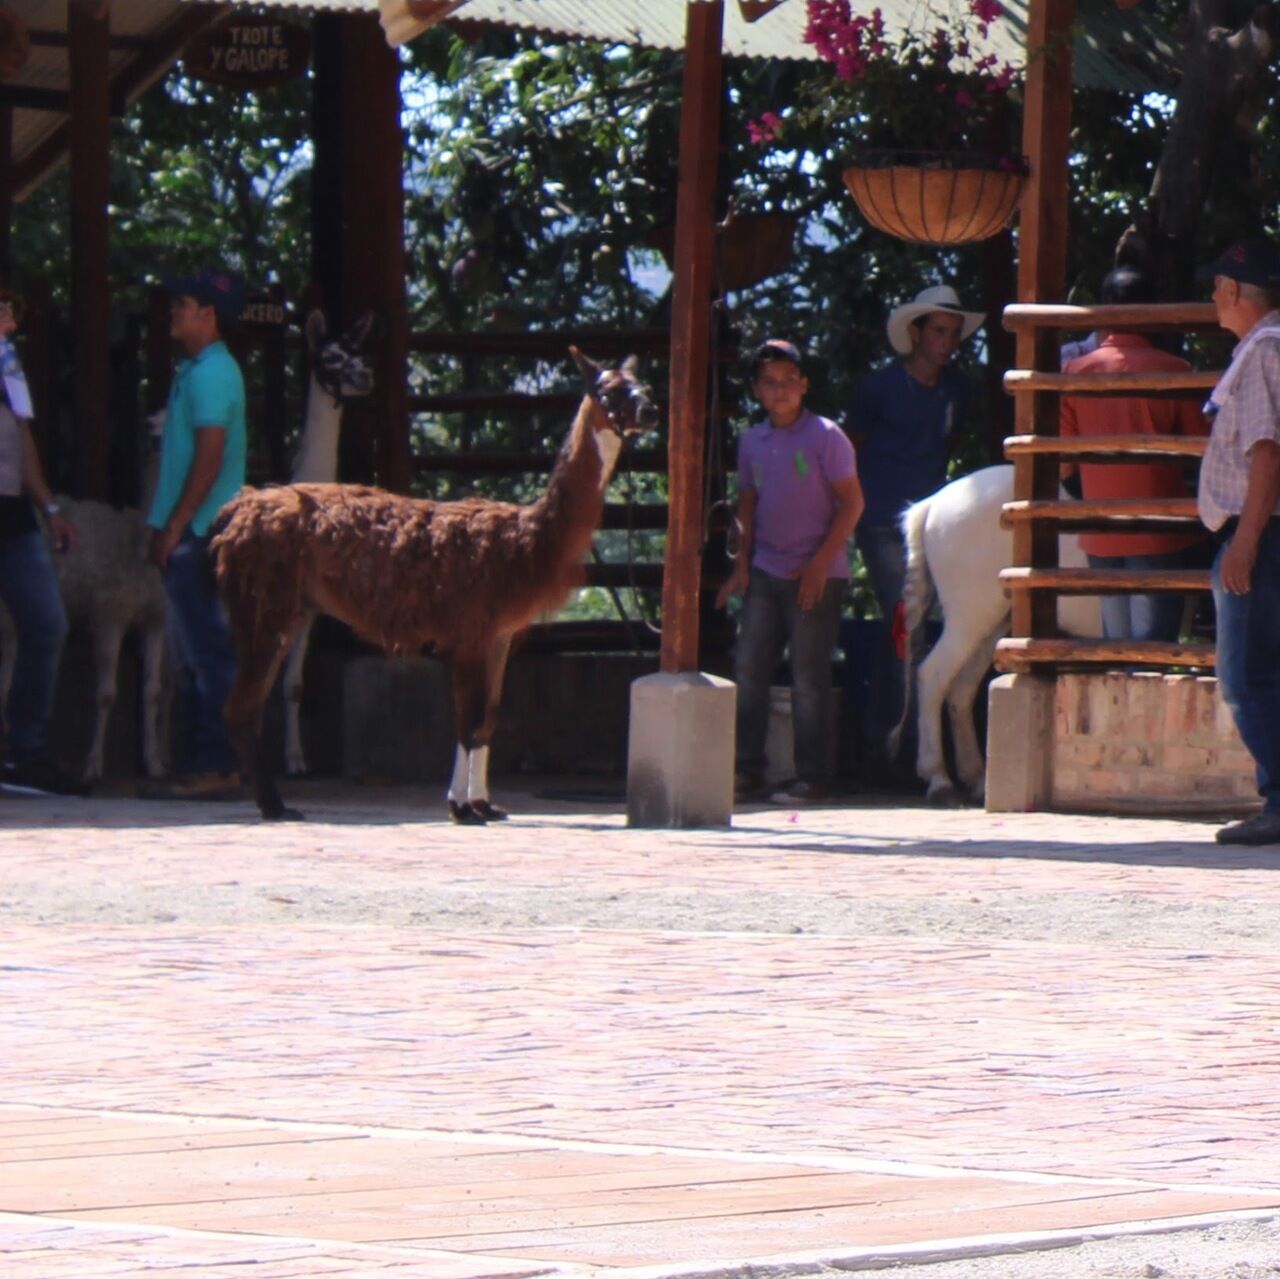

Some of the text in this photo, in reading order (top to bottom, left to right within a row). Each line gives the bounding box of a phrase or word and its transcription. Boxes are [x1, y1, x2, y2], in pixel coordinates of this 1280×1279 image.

[229, 26, 283, 45] TROTE
[225, 47, 289, 72] GALOPE
[238, 303, 284, 324] UCERO
